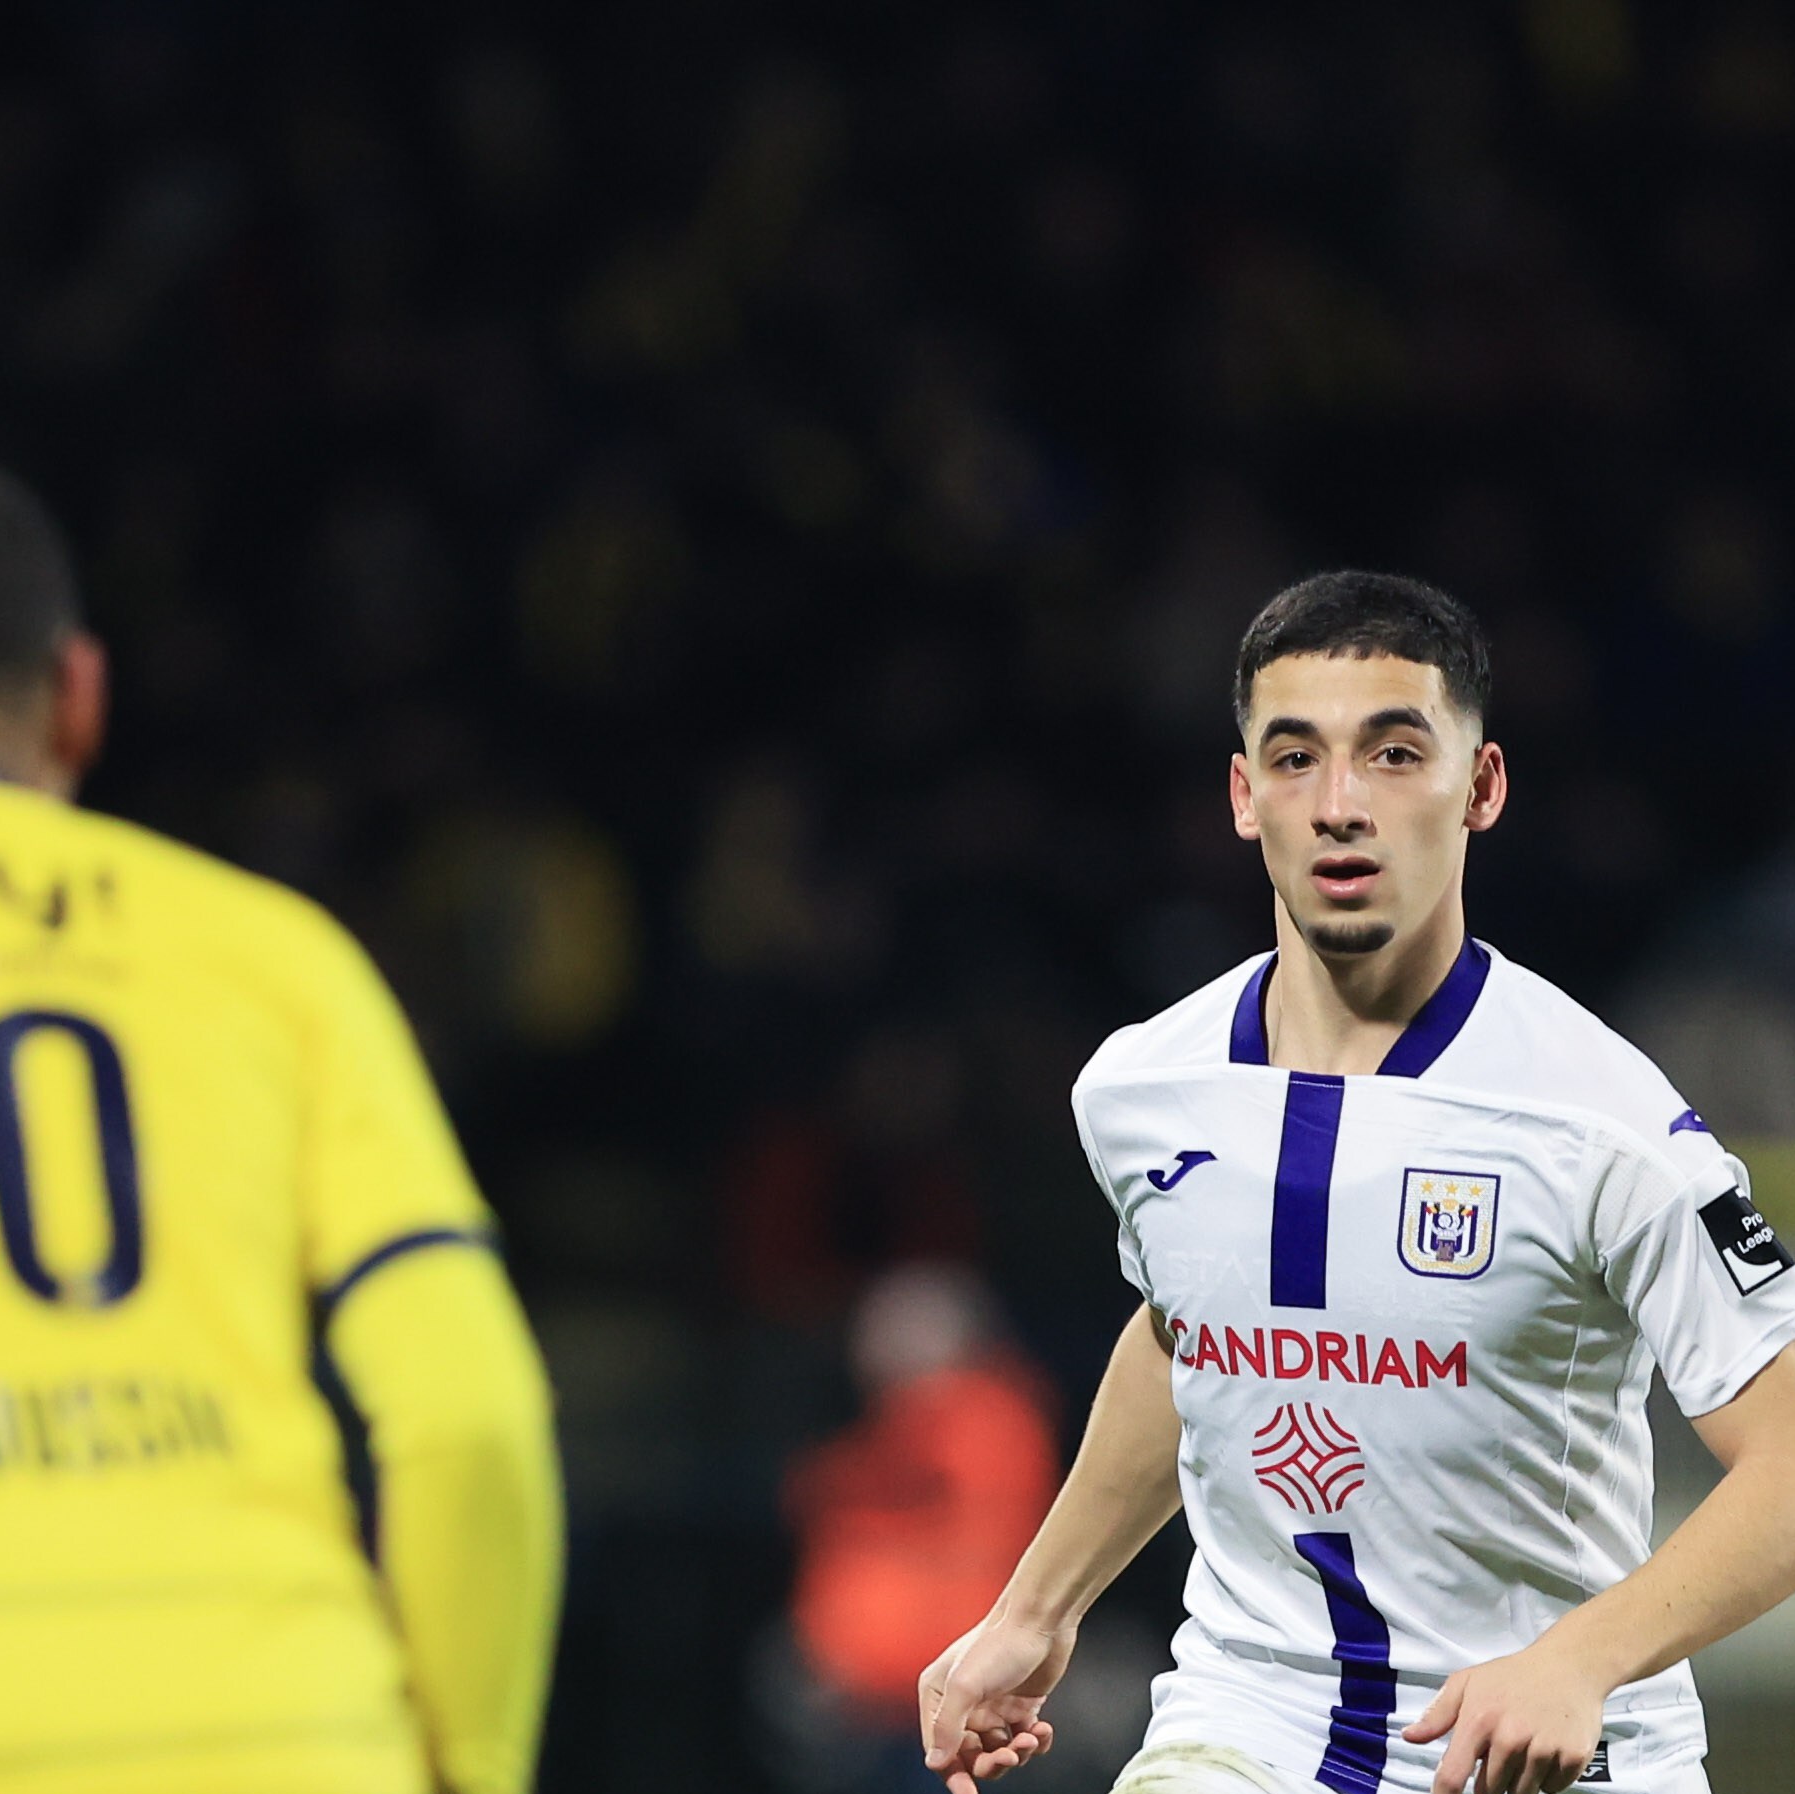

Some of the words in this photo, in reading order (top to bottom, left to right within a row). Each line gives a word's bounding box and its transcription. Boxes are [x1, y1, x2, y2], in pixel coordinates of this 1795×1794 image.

[1741, 1213, 1763, 1231] Pro
[1737, 1226, 1774, 1254] Leag
[1171, 1318, 1467, 1388] CANDRIAM
